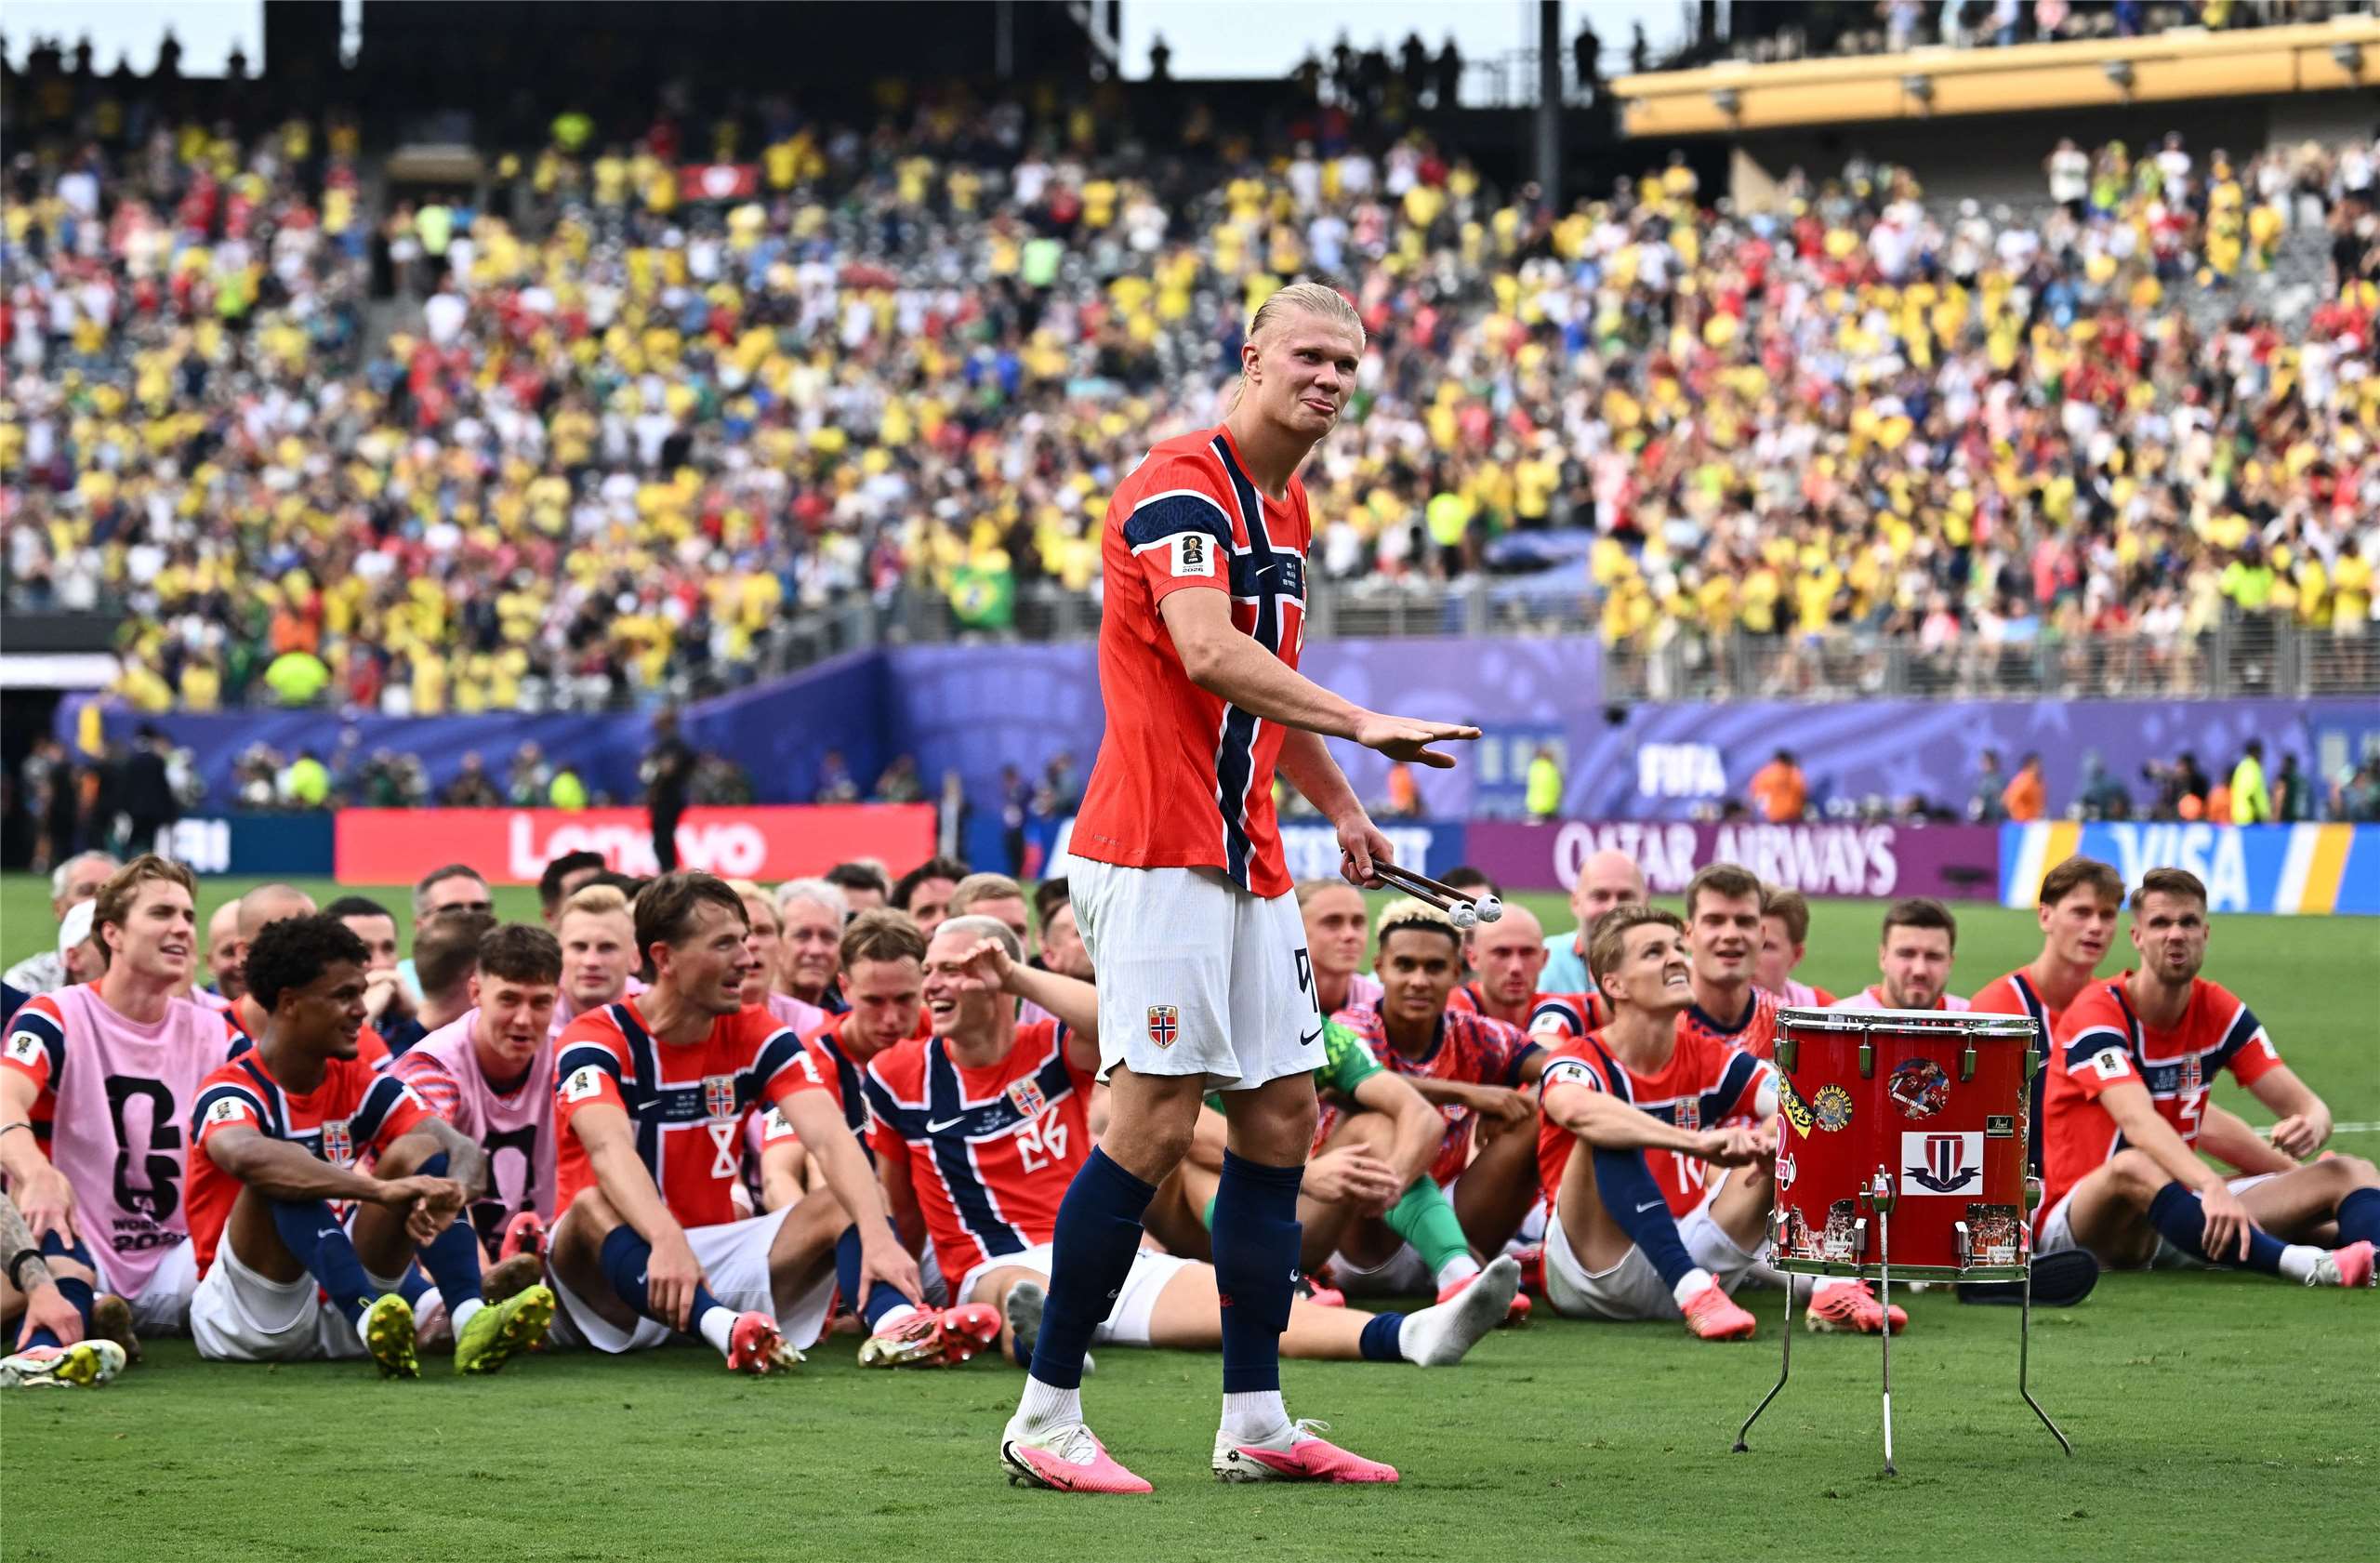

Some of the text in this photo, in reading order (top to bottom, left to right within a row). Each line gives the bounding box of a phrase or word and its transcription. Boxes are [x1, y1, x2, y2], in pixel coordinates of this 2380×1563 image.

[1637, 742, 1726, 797] FIFA
[509, 811, 766, 880] Lenvo
[1294, 947, 1317, 1013] 9
[708, 1122, 738, 1180] 8
[1013, 1106, 1068, 1174] 26
